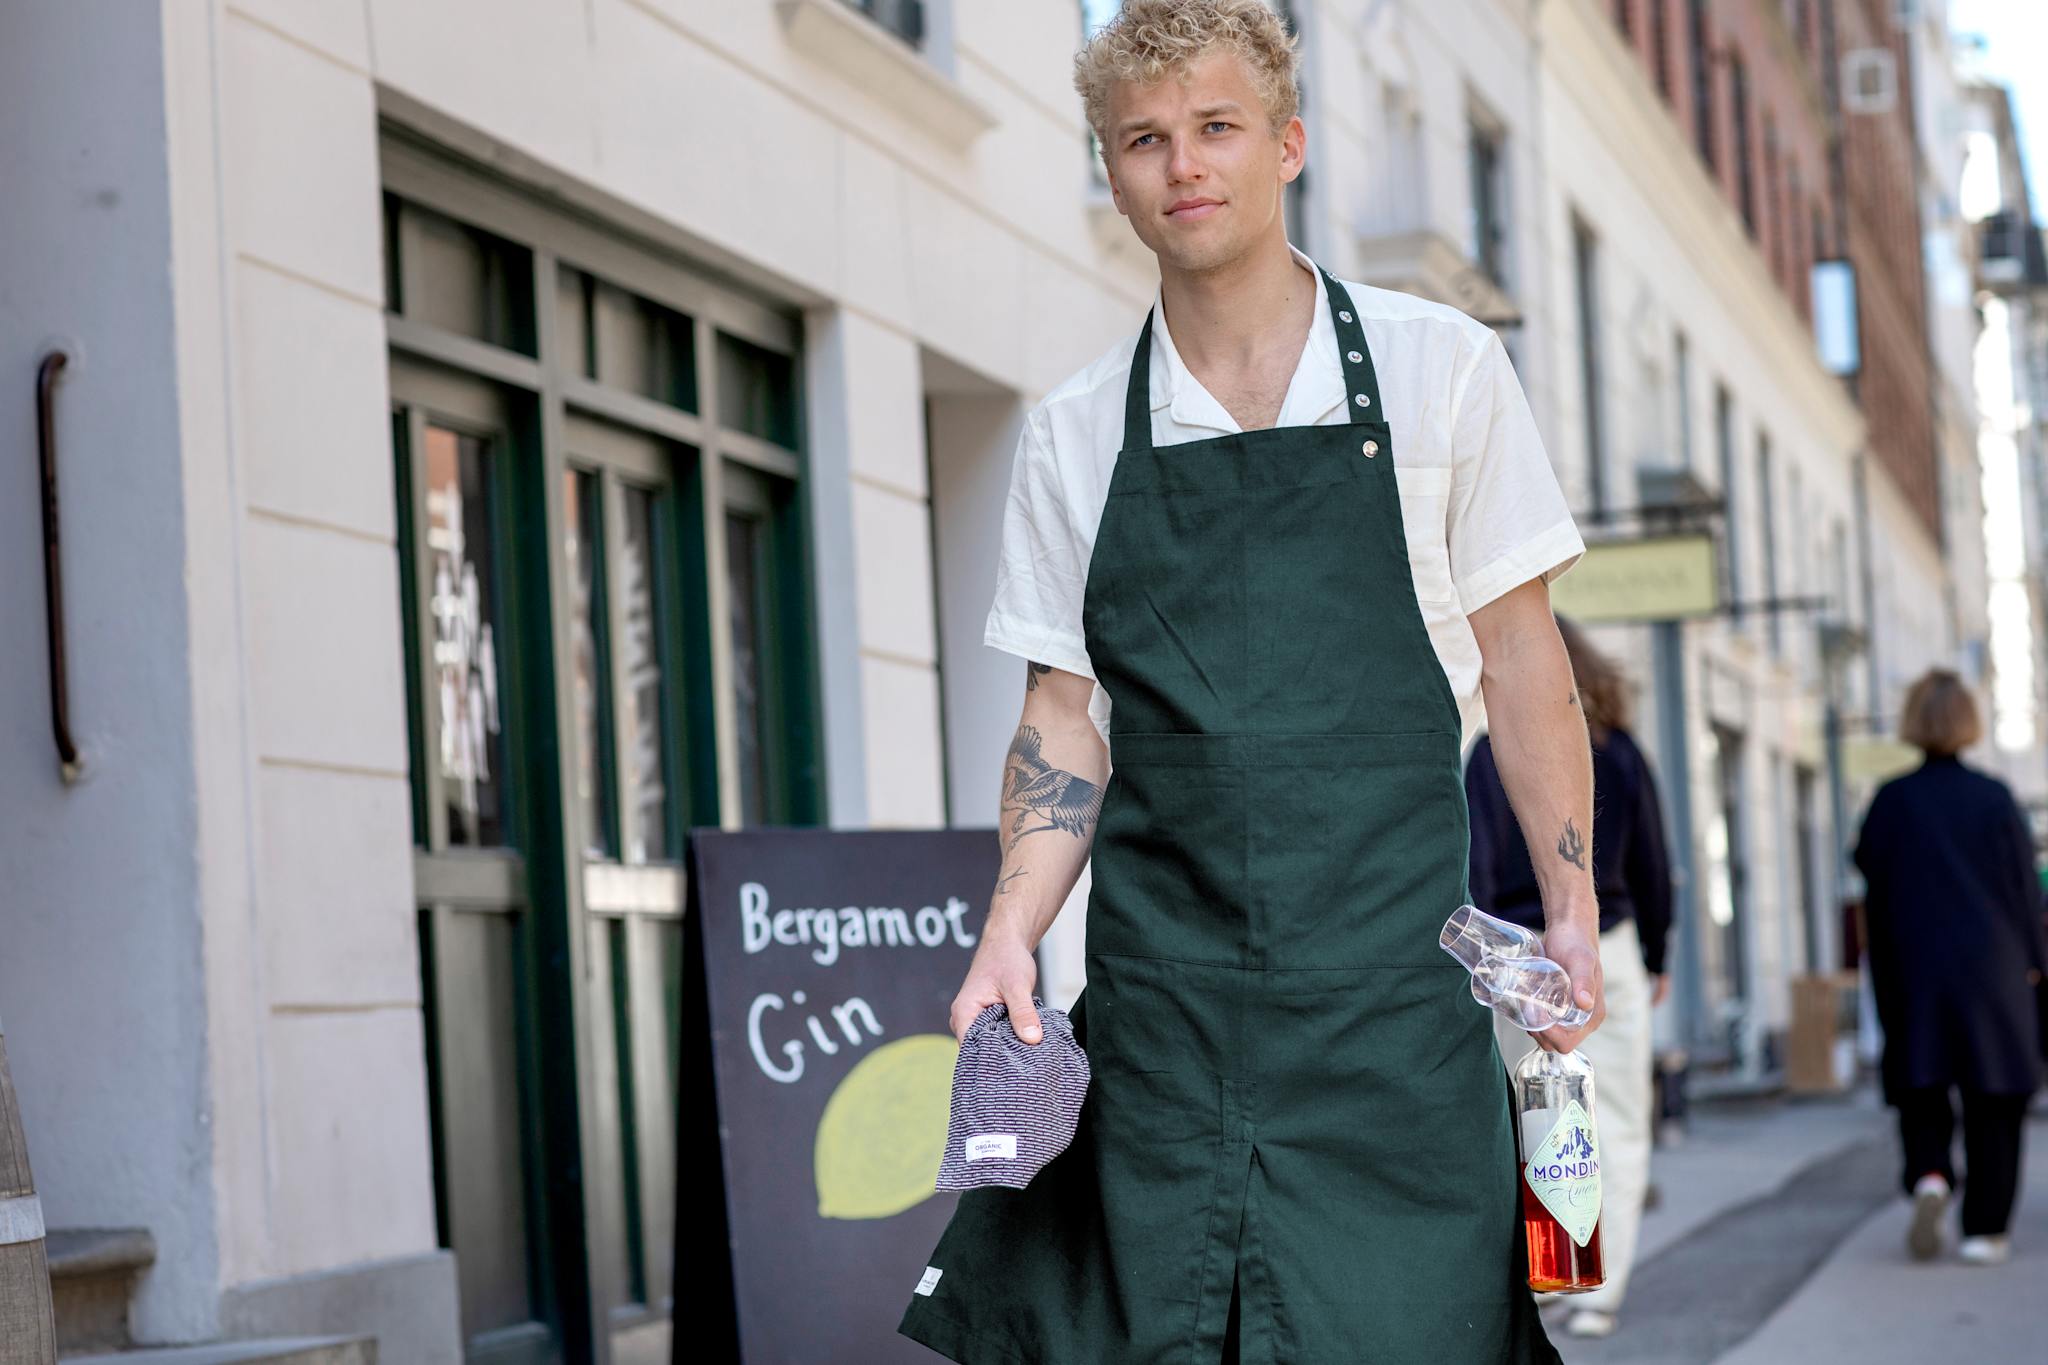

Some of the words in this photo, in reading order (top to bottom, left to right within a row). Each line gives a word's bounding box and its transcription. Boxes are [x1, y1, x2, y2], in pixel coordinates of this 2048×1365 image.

[740, 881, 977, 966] Bergamot
[748, 990, 884, 1083] Gin
[975, 1143, 1002, 1151] ORGANIC
